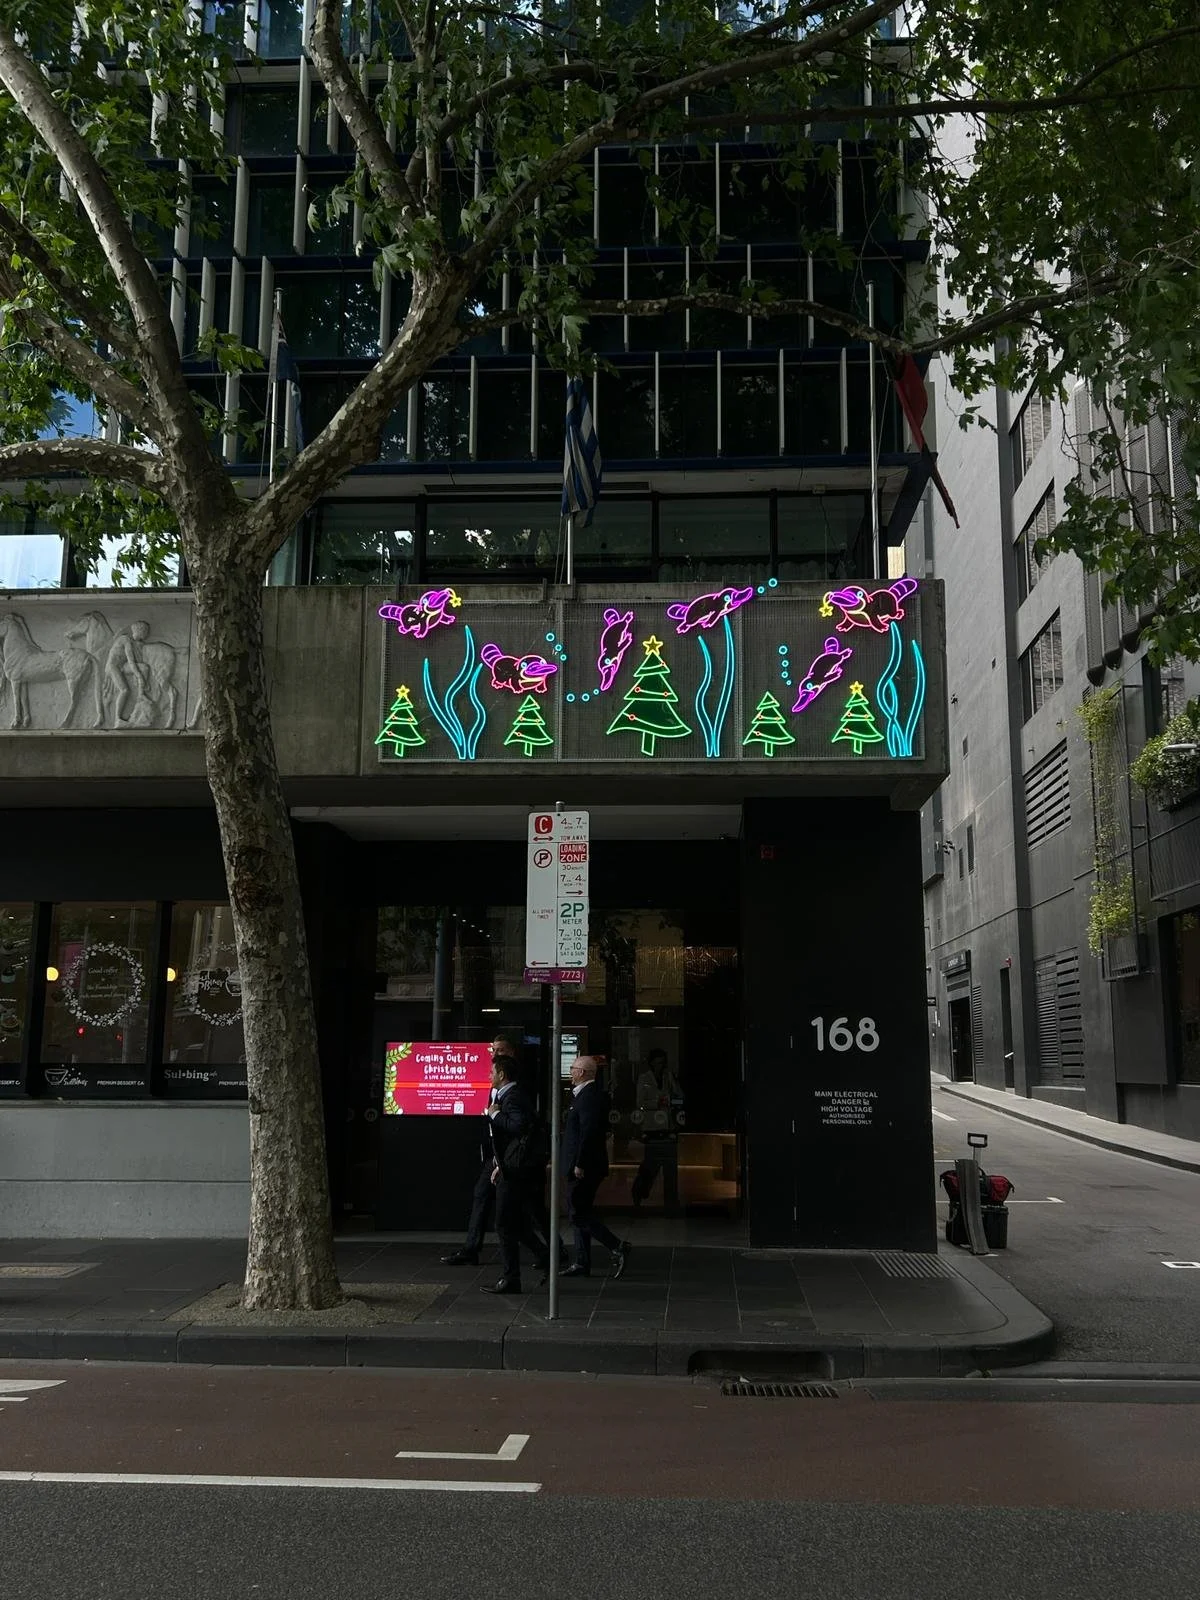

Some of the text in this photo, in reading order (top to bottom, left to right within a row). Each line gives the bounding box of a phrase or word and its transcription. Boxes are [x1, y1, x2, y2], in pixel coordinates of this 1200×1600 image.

[560, 844, 586, 853] LOADING
[560, 854, 586, 863] ZONE
[560, 902, 585, 918] 2P
[560, 970, 581, 979] 7773
[811, 1016, 880, 1052] 168
[416, 1052, 479, 1064] Coming Out For
[424, 1064, 467, 1075] Christmas
